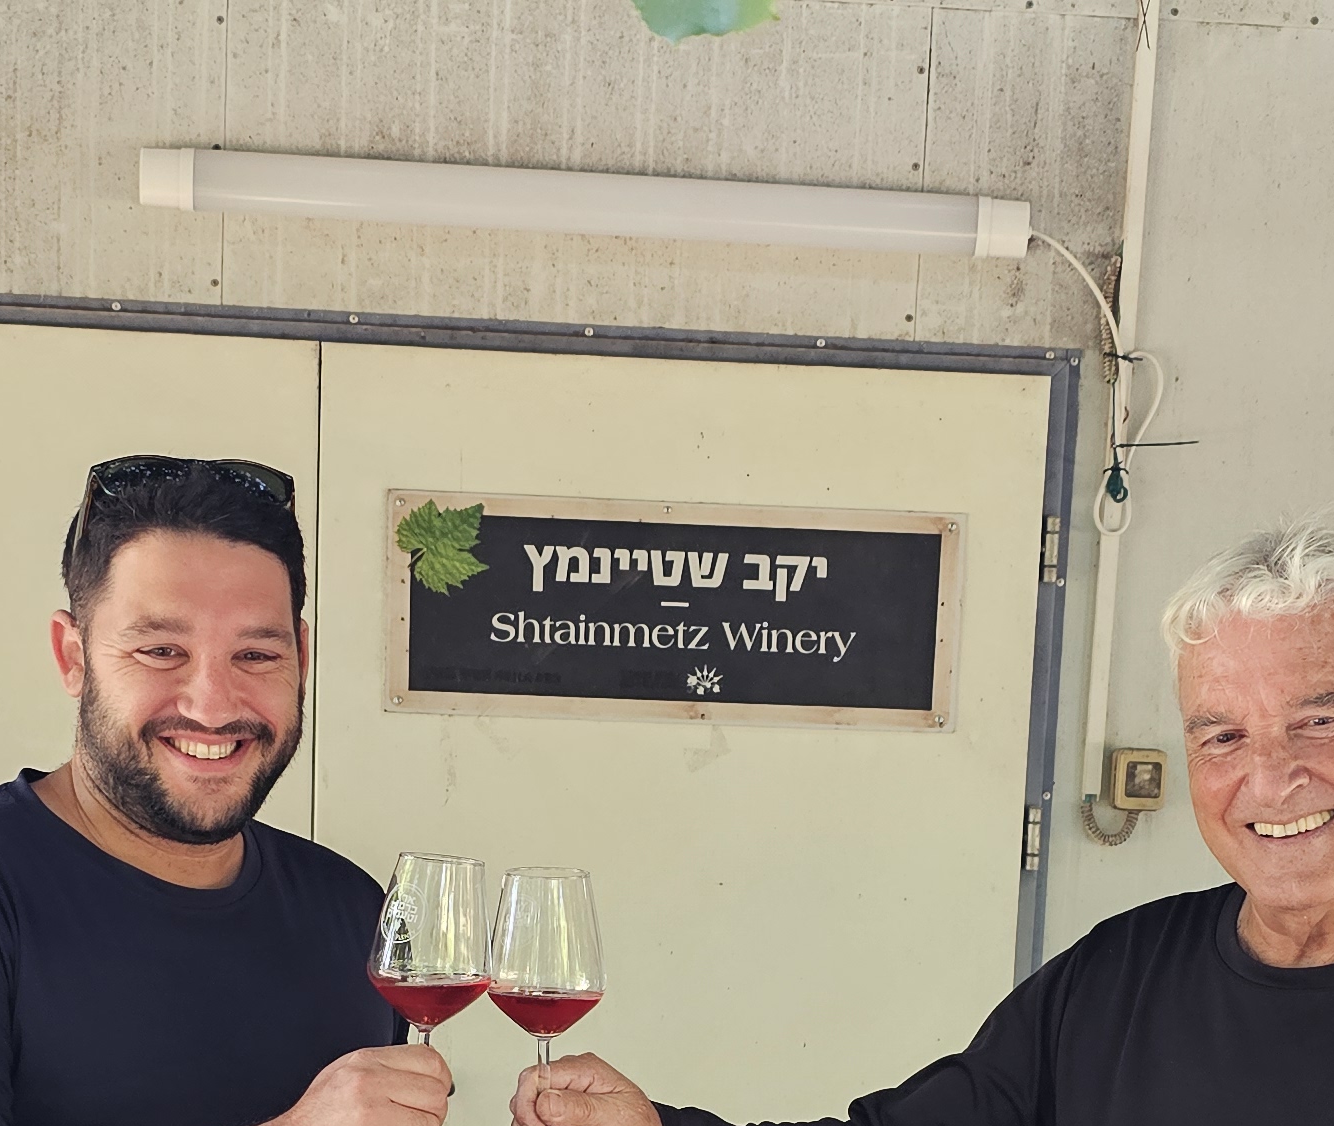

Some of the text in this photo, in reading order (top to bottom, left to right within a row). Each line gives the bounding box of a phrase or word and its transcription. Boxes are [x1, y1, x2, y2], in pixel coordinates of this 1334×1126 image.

[524, 545, 828, 602] יקב שטיינמץ
[489, 611, 857, 663] Shtainmetz Winery
